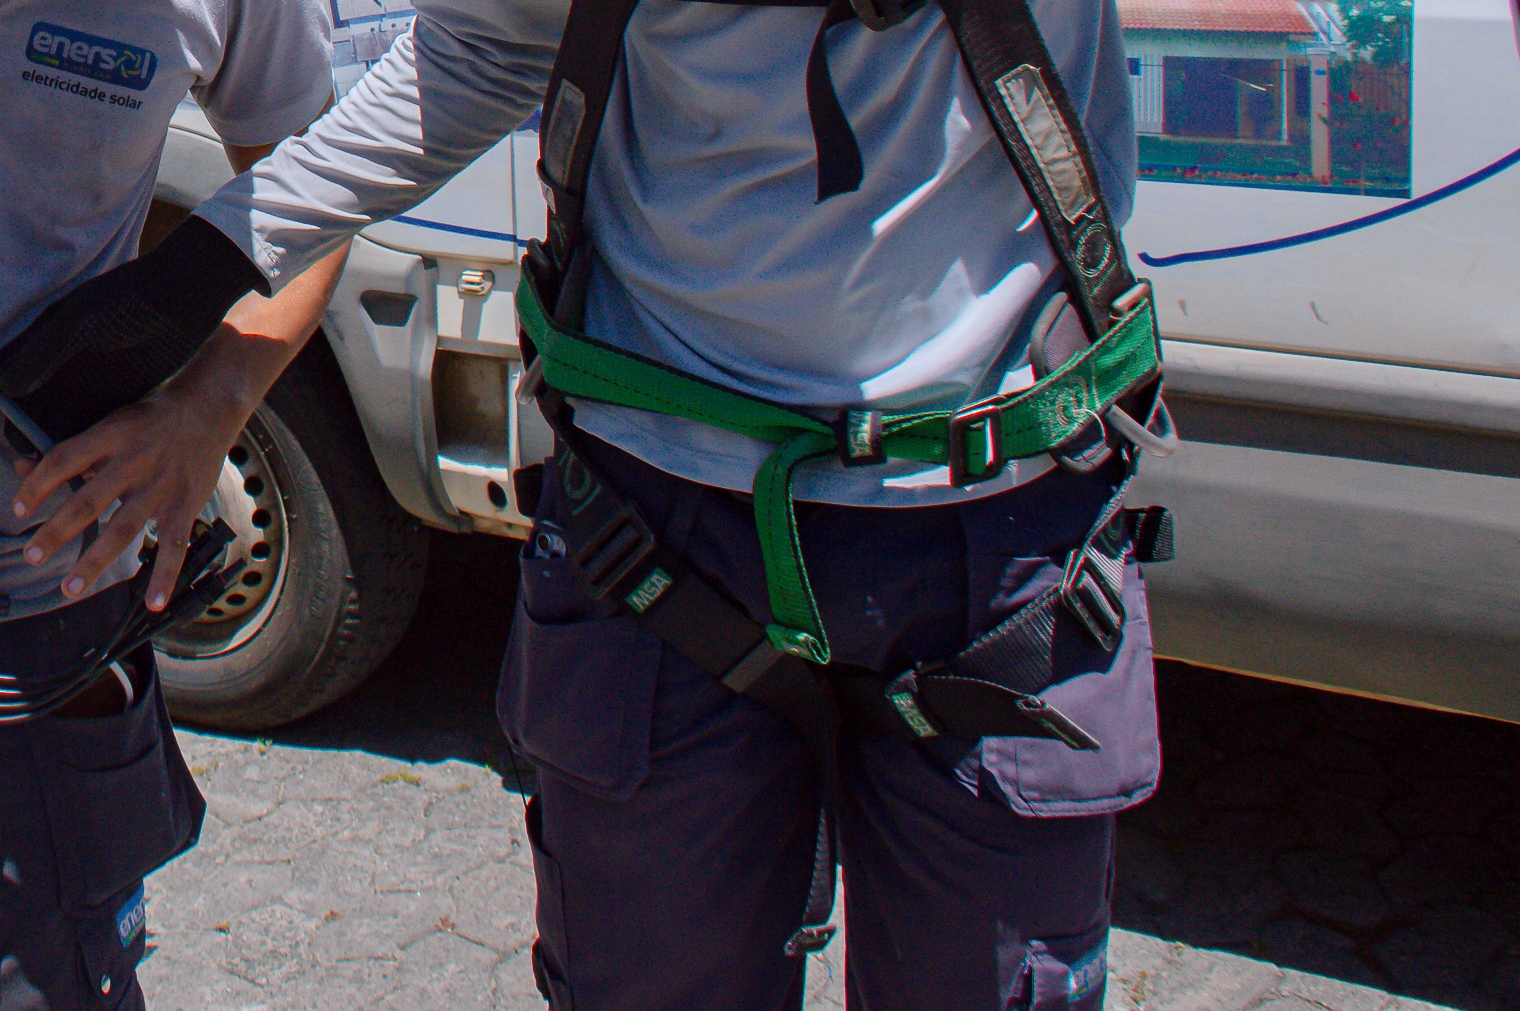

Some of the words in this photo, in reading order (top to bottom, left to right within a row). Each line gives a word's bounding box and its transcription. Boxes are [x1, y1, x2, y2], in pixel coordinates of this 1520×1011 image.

[21, 69, 106, 102] eletricidade
[108, 93, 143, 110] solar
[632, 574, 671, 611] MSA
